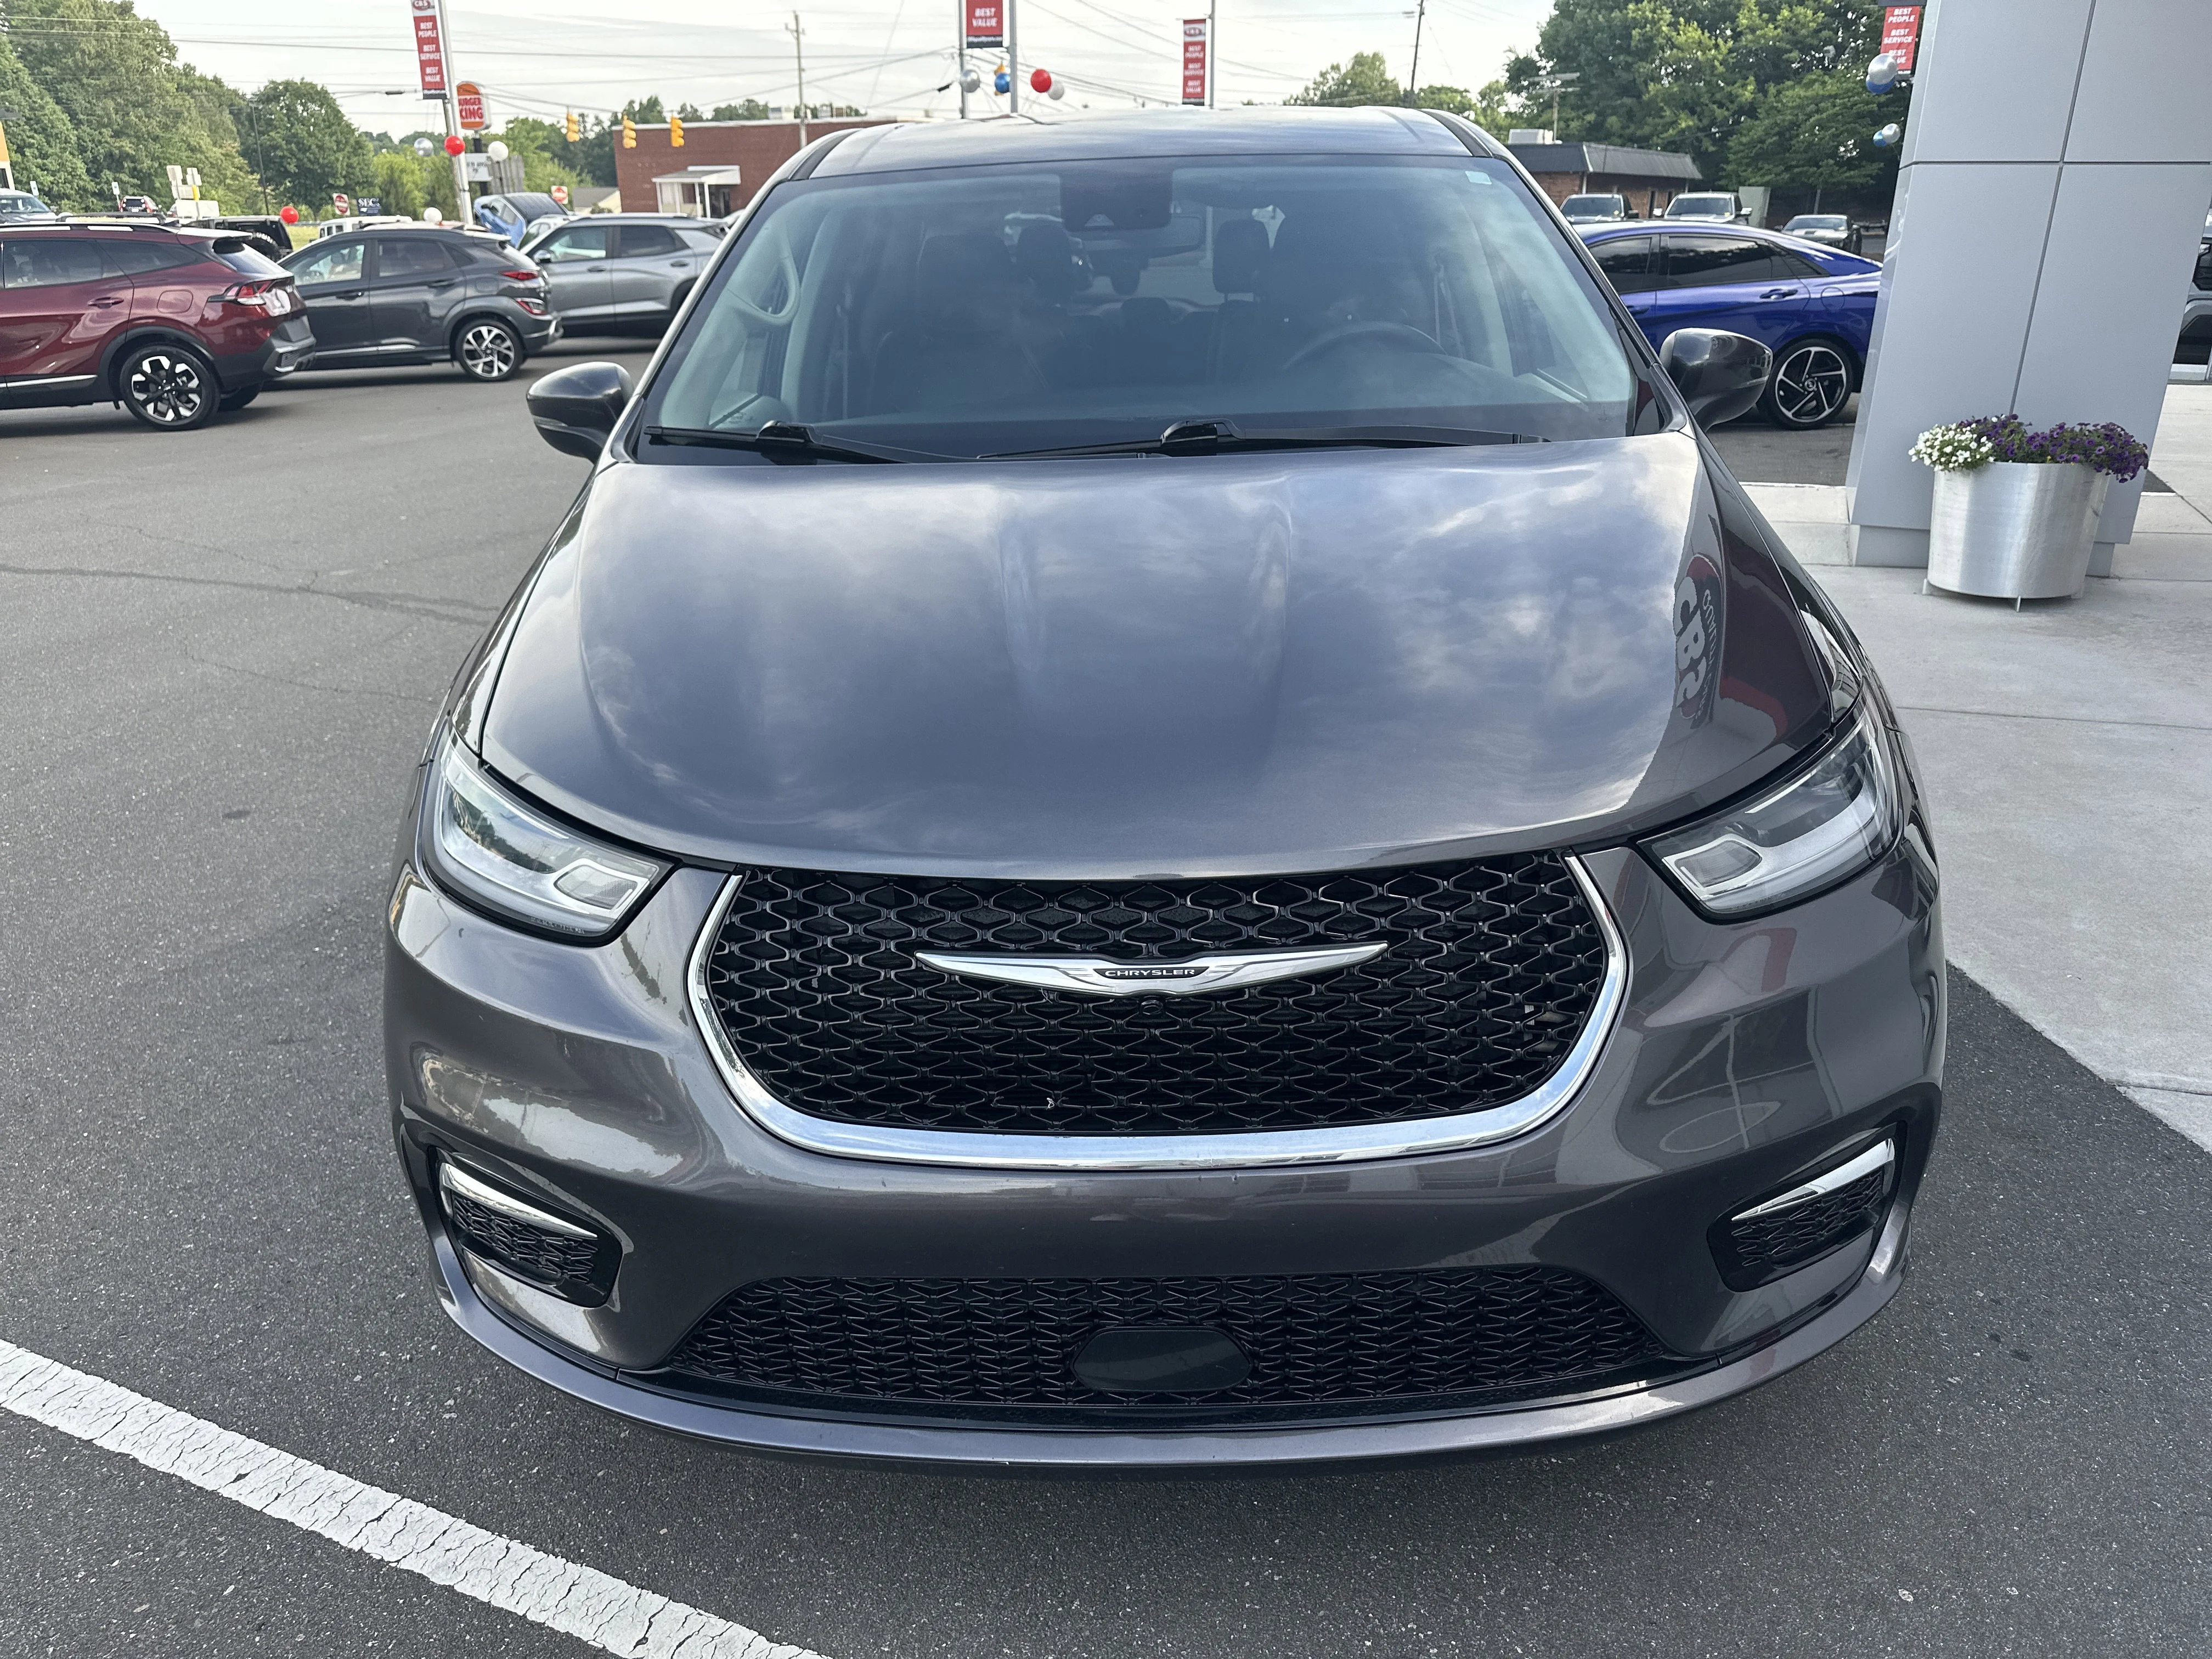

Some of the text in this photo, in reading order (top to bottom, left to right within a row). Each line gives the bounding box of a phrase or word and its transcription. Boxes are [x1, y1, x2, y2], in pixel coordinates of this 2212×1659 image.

[975, 7, 996, 17] BEST
[972, 18, 997, 27] VALUE
[1888, 15, 1915, 23] PEOPLE
[418, 30, 437, 38] PEOPLE
[1883, 36, 1914, 44] SERVICE
[420, 52, 441, 60] SERVICE
[425, 74, 441, 82] VALUE
[459, 98, 481, 106] URGER
[460, 107, 483, 119] KING
